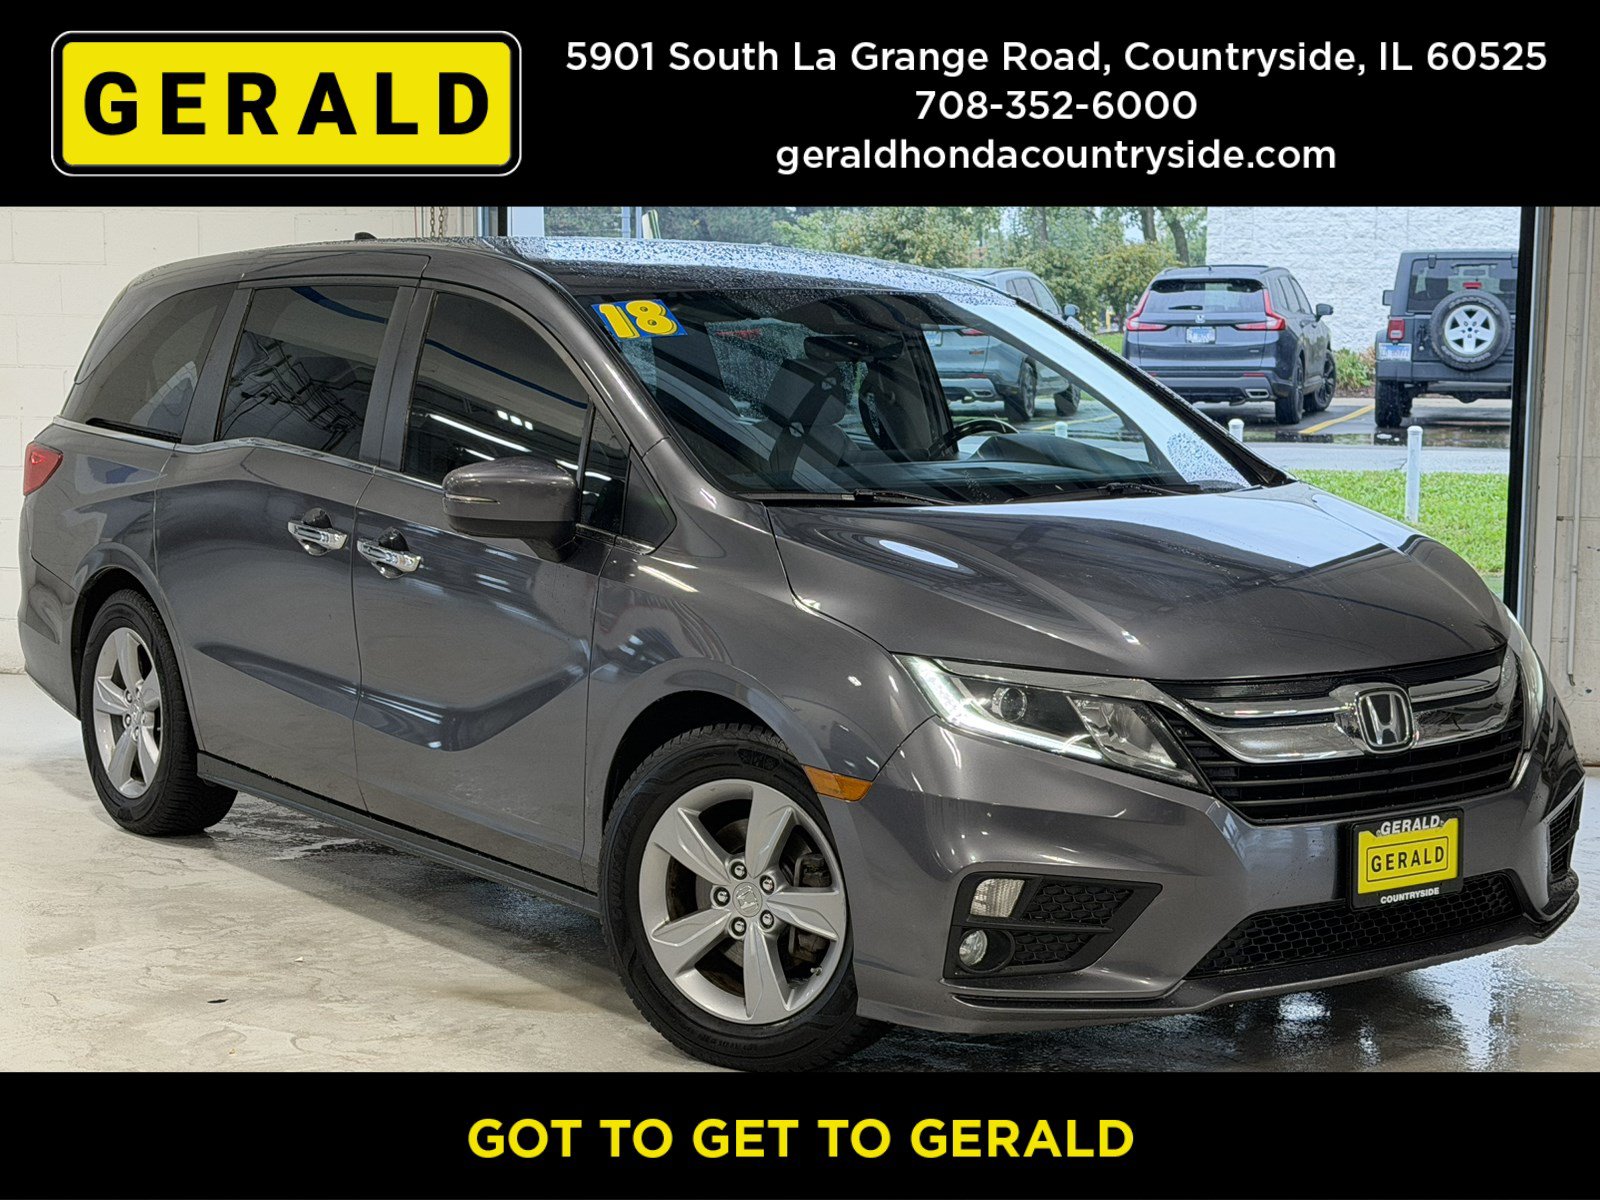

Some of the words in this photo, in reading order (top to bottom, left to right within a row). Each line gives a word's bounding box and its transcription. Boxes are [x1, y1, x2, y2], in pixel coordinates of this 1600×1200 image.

[599, 300, 678, 339] 18
[1380, 815, 1440, 836] GERALD
[1371, 846, 1444, 873] GERALD
[1380, 887, 1440, 904] COUNTRYSIDE
